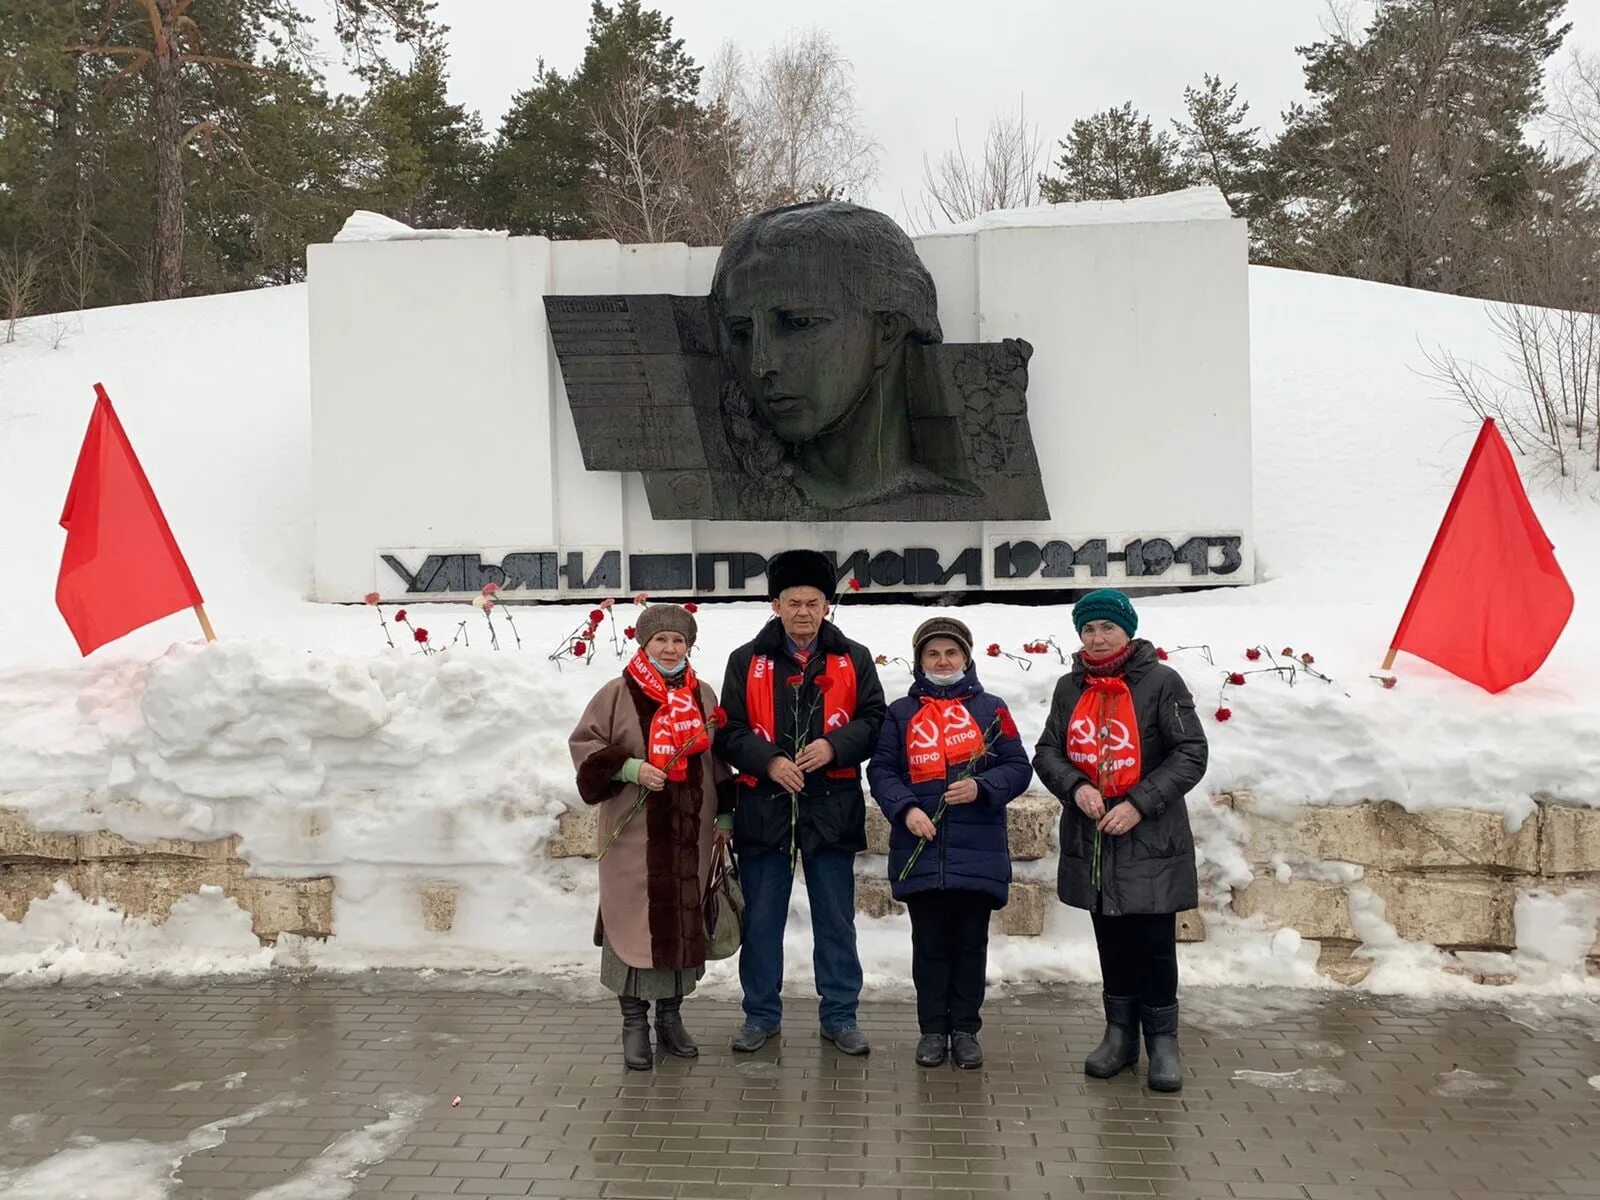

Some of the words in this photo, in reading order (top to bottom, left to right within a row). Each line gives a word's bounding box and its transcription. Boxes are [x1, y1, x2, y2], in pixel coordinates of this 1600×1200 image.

[381, 551, 621, 592] УЛЬЯНА
[696, 548, 982, 590] ГРМОВА
[994, 536, 1242, 579] 1924-1943
[673, 718, 701, 733] КПРФ
[944, 729, 977, 747] КПРФ
[910, 751, 941, 765] КПРФ
[1069, 751, 1098, 764] КПРФ
